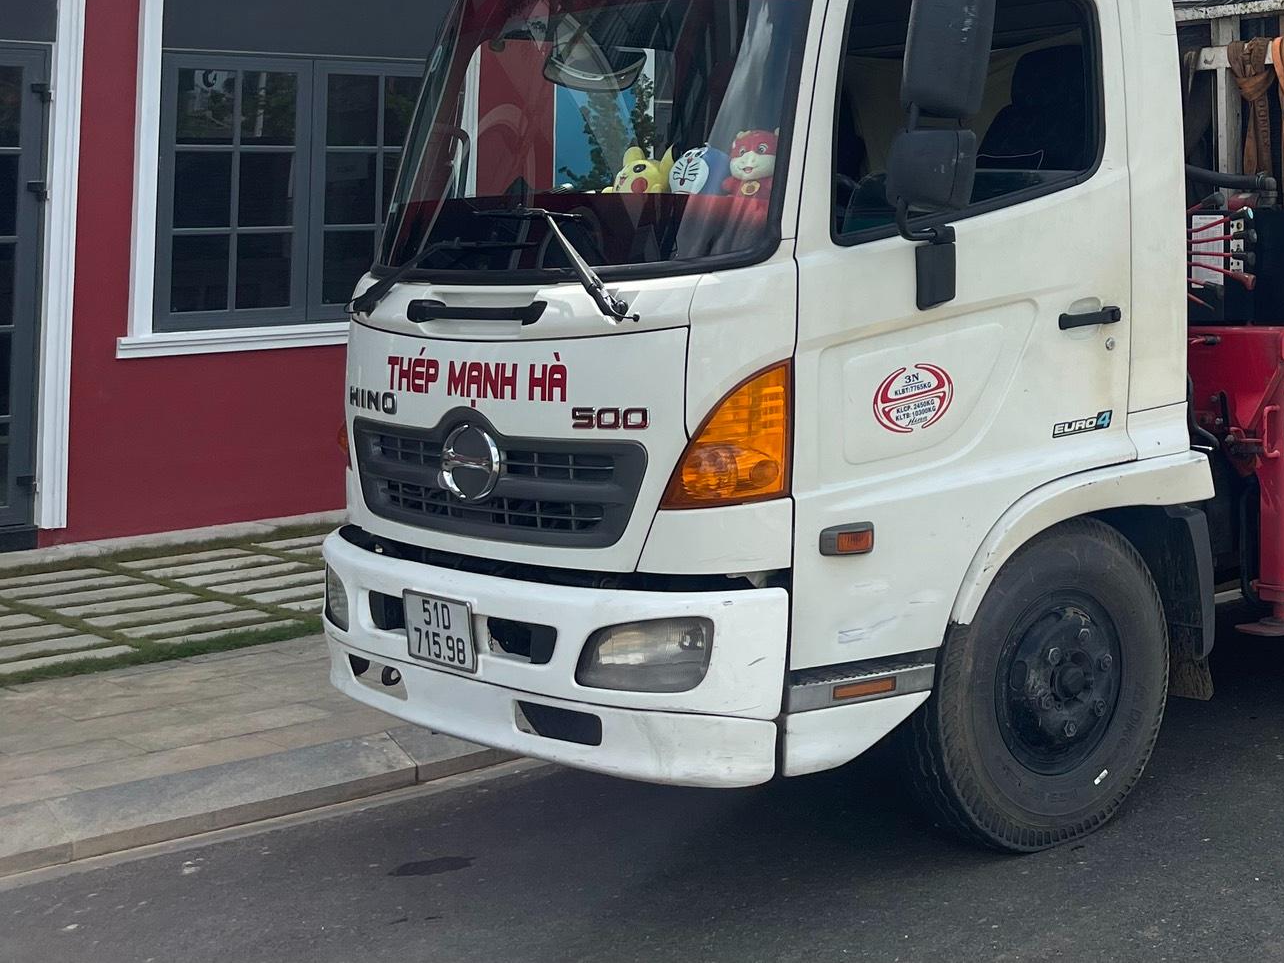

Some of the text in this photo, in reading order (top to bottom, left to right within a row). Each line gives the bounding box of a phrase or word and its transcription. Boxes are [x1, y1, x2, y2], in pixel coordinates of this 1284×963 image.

[388, 347, 568, 407] THÉP MẠNH HÀ
[904, 373, 919, 384] 3N
[350, 385, 397, 415] HINO
[571, 406, 650, 430] 500
[422, 599, 450, 630] 51D
[414, 626, 466, 664] 715.98
